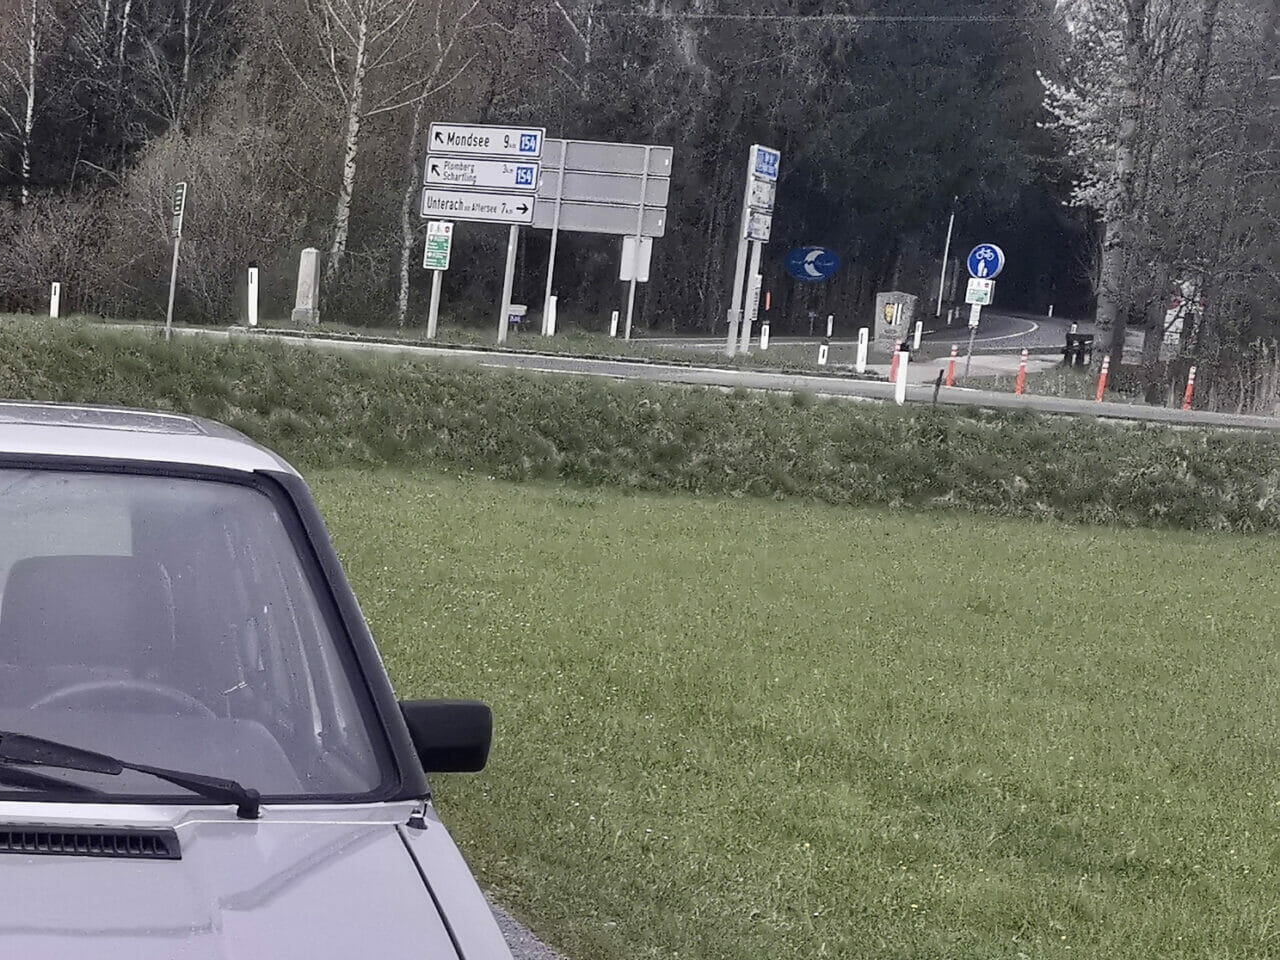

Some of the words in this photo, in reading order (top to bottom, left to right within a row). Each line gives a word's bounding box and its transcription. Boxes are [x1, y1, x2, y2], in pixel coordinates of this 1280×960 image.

[446, 132, 490, 148] Mondsee
[521, 135, 536, 150] 154
[517, 168, 533, 184] 154
[426, 196, 463, 211] Unterach
[471, 203, 497, 213] Attersee
